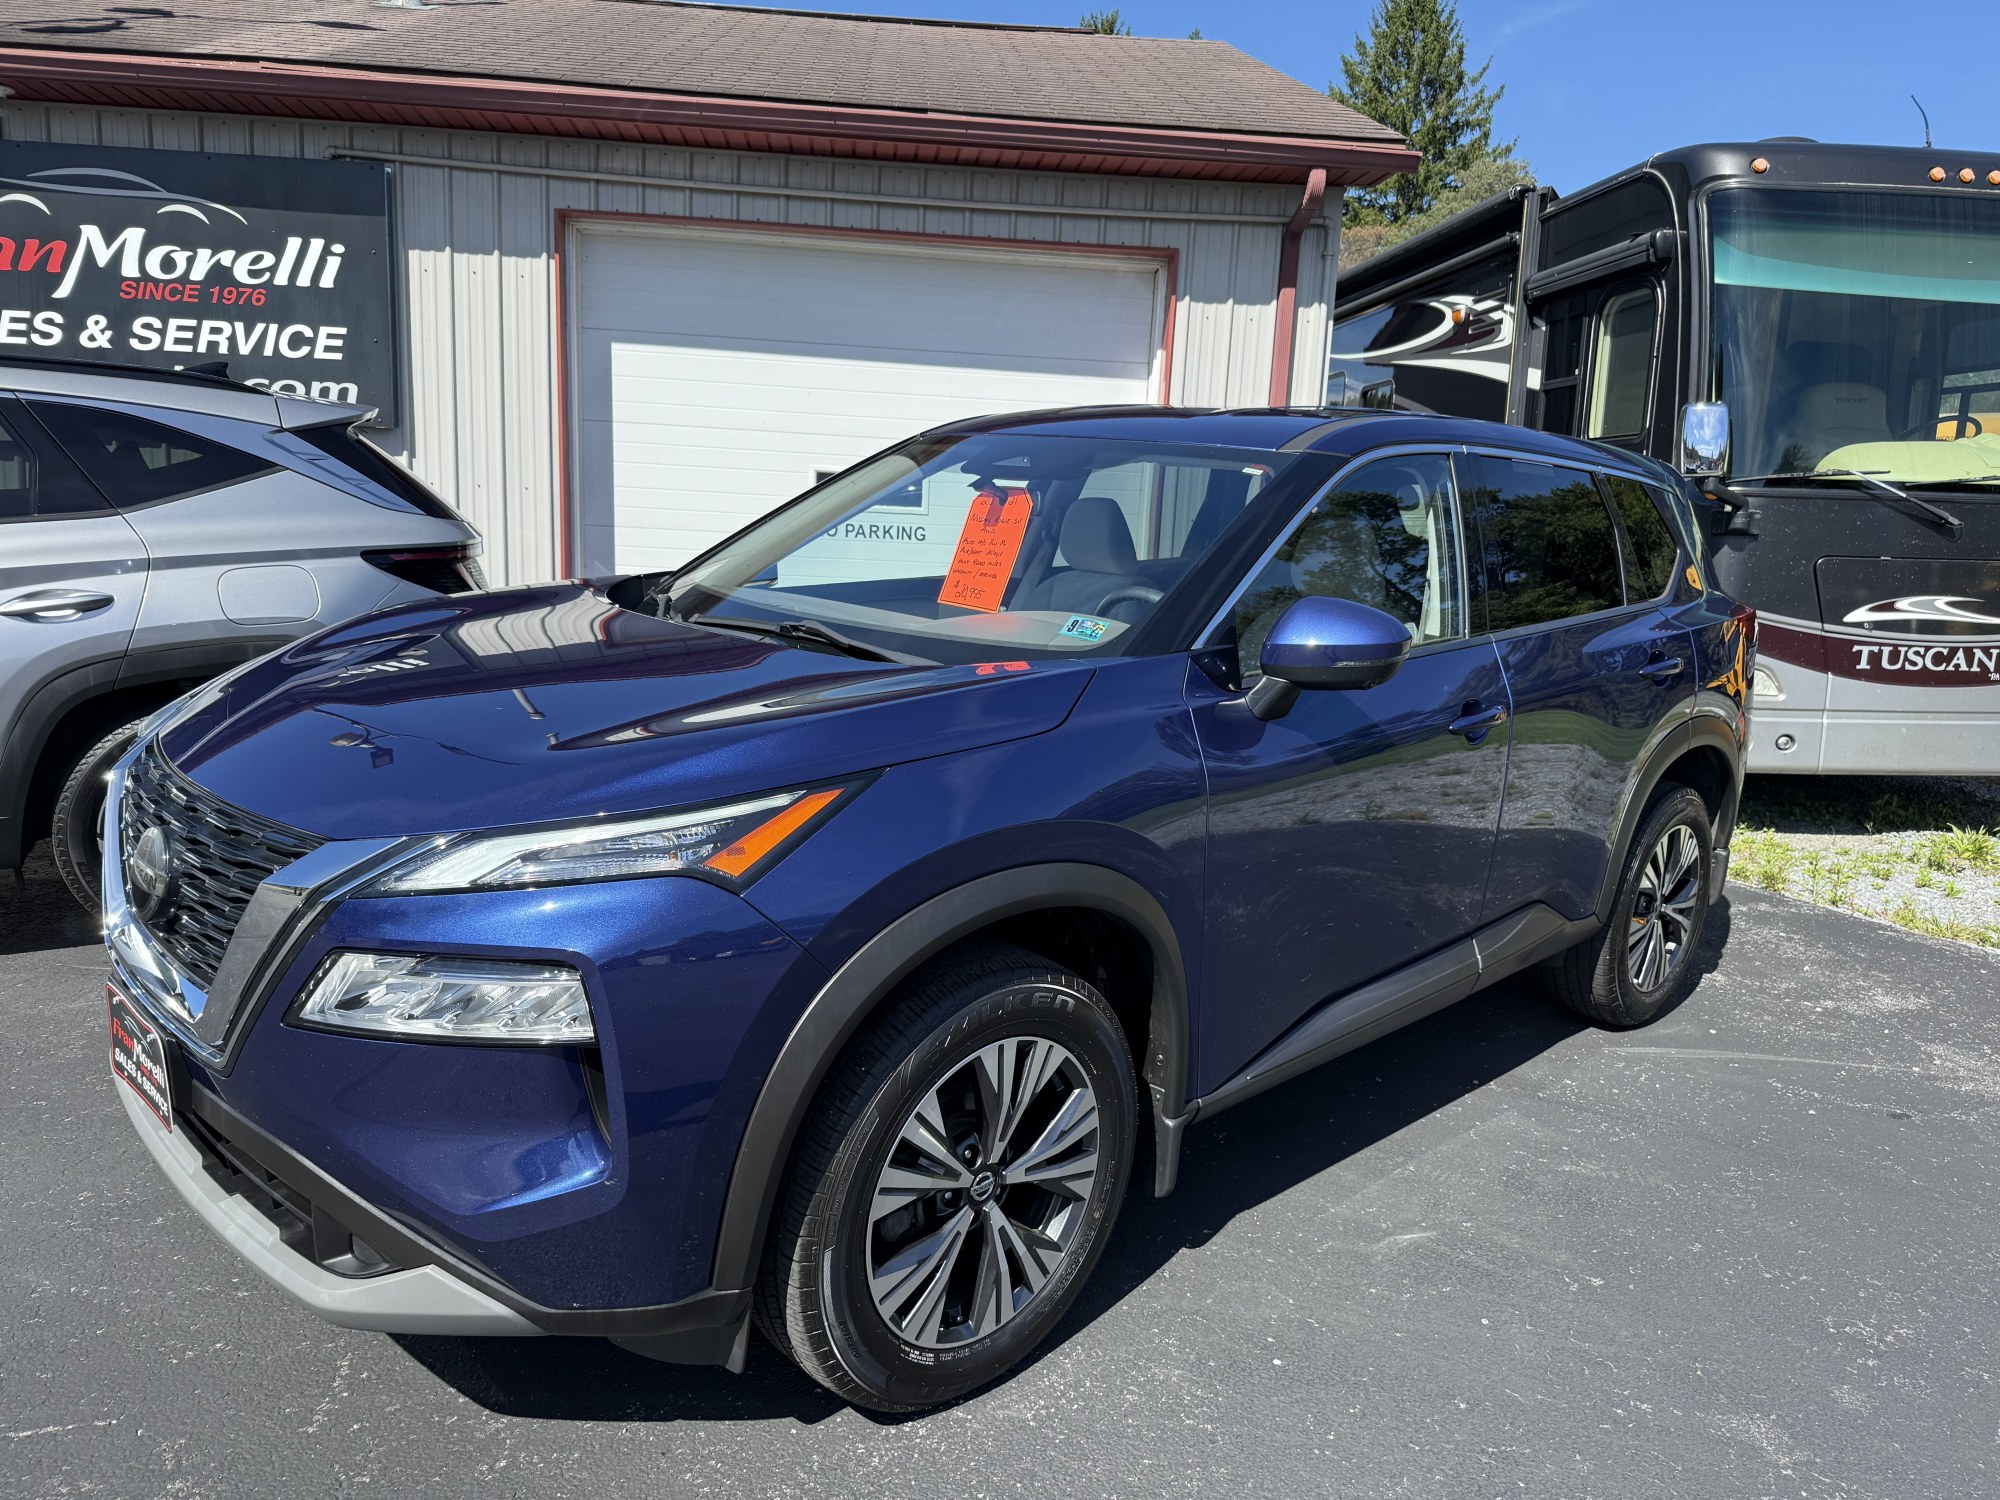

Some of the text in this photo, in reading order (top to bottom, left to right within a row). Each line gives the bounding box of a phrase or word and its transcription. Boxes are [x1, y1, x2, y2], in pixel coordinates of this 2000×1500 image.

[119, 280, 267, 307] SINCE 1976
[0, 309, 347, 361] ES & SERVICE
[845, 523, 926, 541] PARKING
[1852, 644, 1999, 672] TUSCAN
[115, 1047, 137, 1078] SALES
[137, 1070, 142, 1085] &
[142, 1076, 169, 1117] SERVICE
